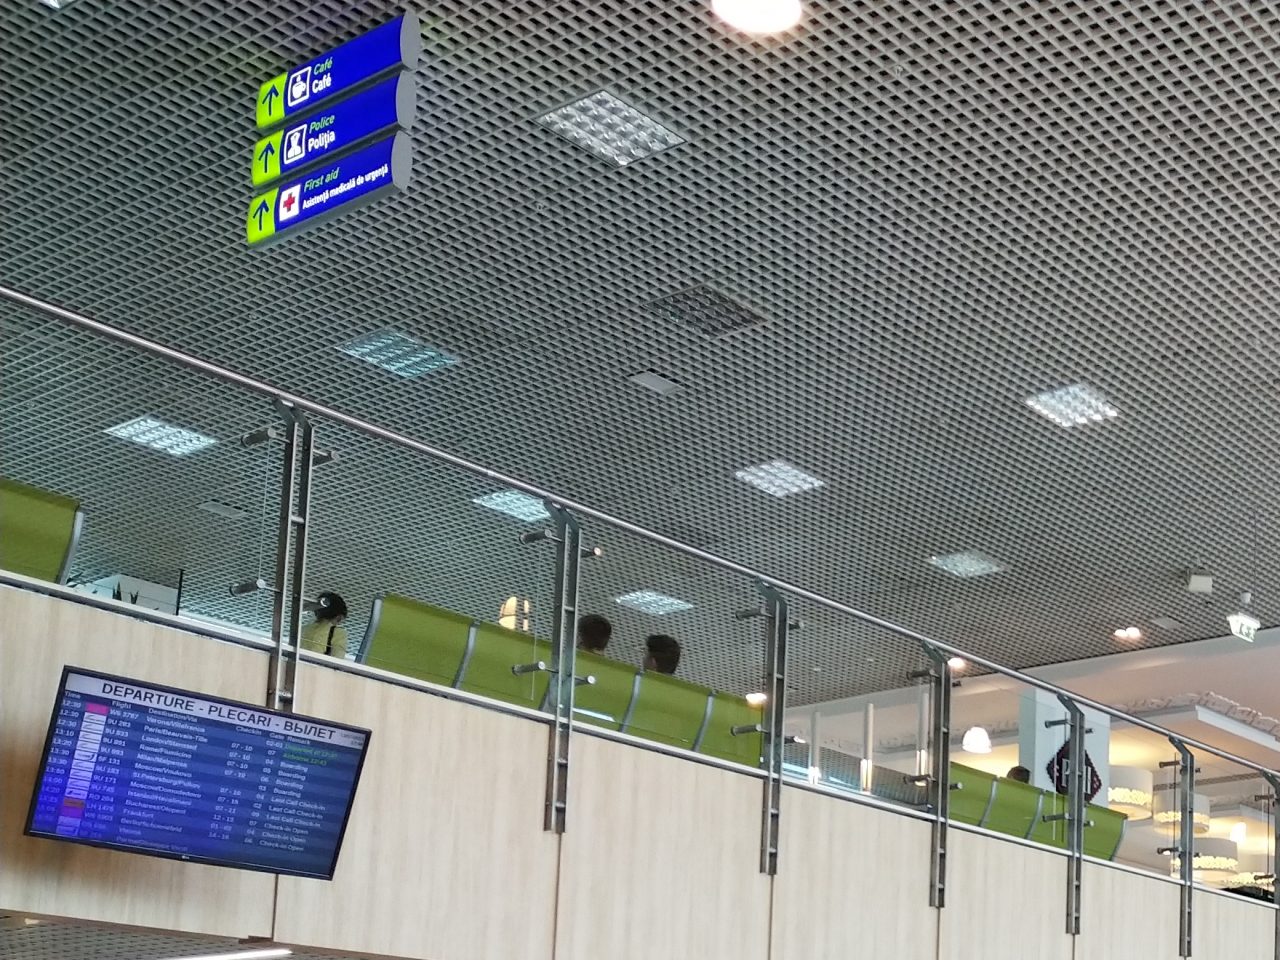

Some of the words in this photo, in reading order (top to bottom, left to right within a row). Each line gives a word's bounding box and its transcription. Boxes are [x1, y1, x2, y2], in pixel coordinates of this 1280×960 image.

[314, 57, 333, 76] Café
[312, 72, 332, 94] Café
[309, 114, 335, 134] Police
[303, 174, 324, 193] First
[325, 167, 340, 181] aid
[357, 174, 364, 186] de
[100, 682, 195, 711] DEPARTURE
[207, 704, 272, 727] PLECARI
[283, 720, 336, 740] ВЫЛЕТ
